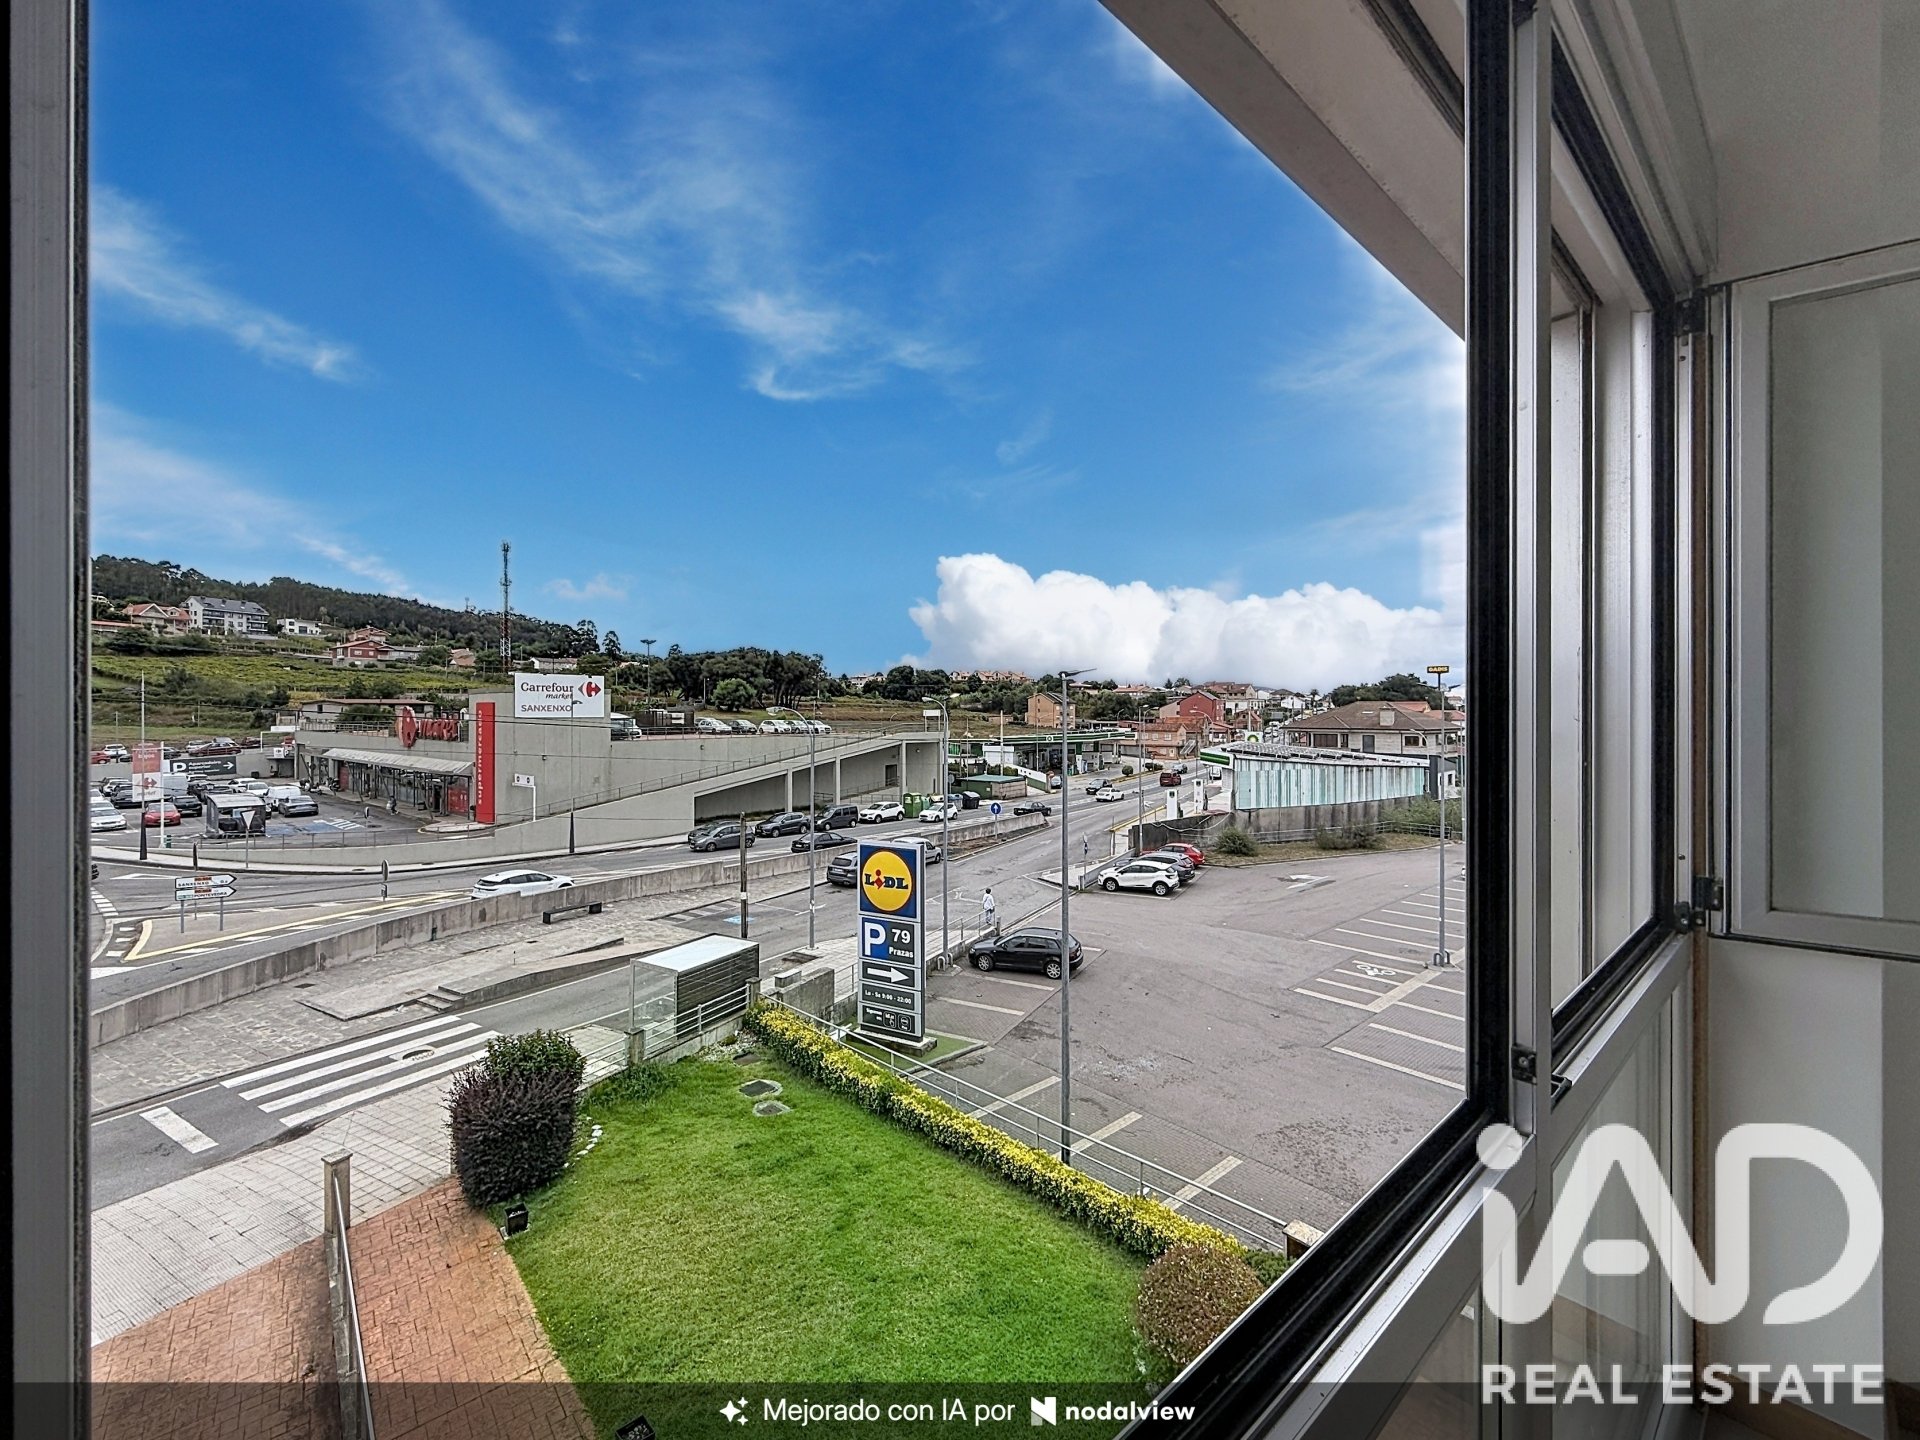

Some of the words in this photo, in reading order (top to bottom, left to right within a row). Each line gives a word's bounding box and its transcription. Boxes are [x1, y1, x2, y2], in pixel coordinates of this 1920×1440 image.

[520, 682, 573, 693] Carrefour
[521, 704, 573, 712] SANXENXO
[172, 762, 187, 773] P
[864, 921, 886, 956] P
[891, 928, 911, 944] 79
[888, 946, 914, 958] Prazas
